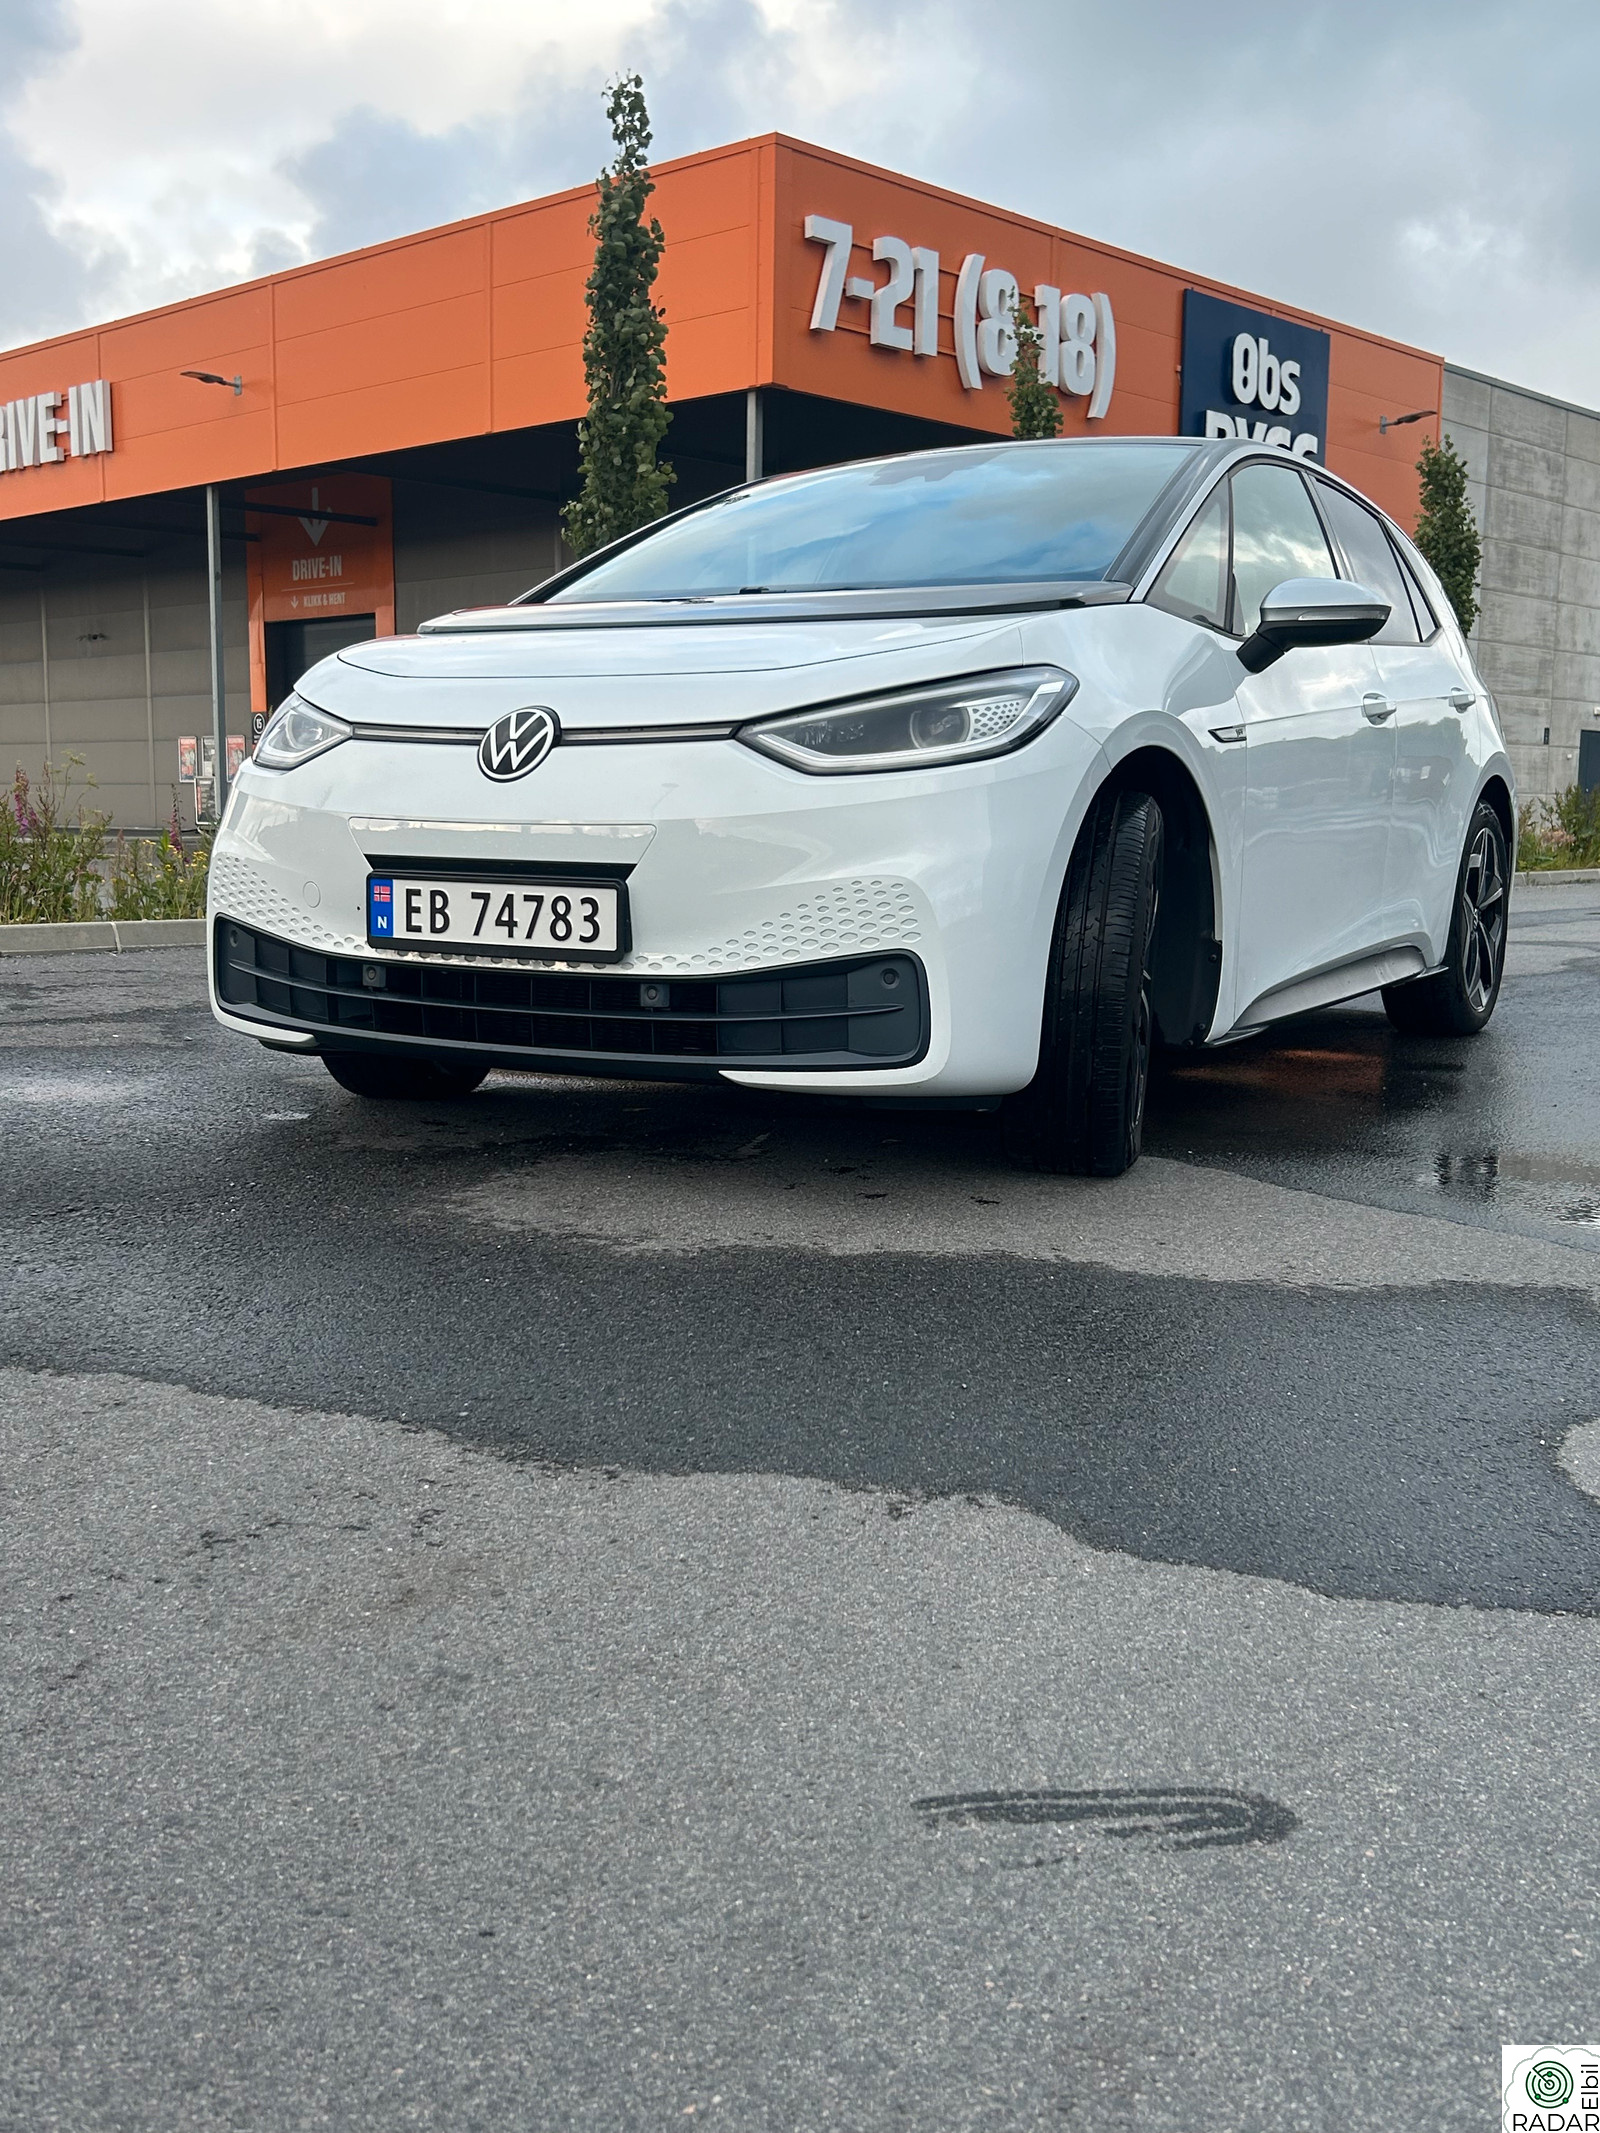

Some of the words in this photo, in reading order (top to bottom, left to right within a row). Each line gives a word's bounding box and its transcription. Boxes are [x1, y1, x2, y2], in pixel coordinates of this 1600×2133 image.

[804, 214, 940, 357] 7-21
[292, 555, 342, 581] DRIVE-IN
[377, 915, 388, 930] N
[405, 888, 450, 934] EB
[471, 891, 601, 943] 74783
